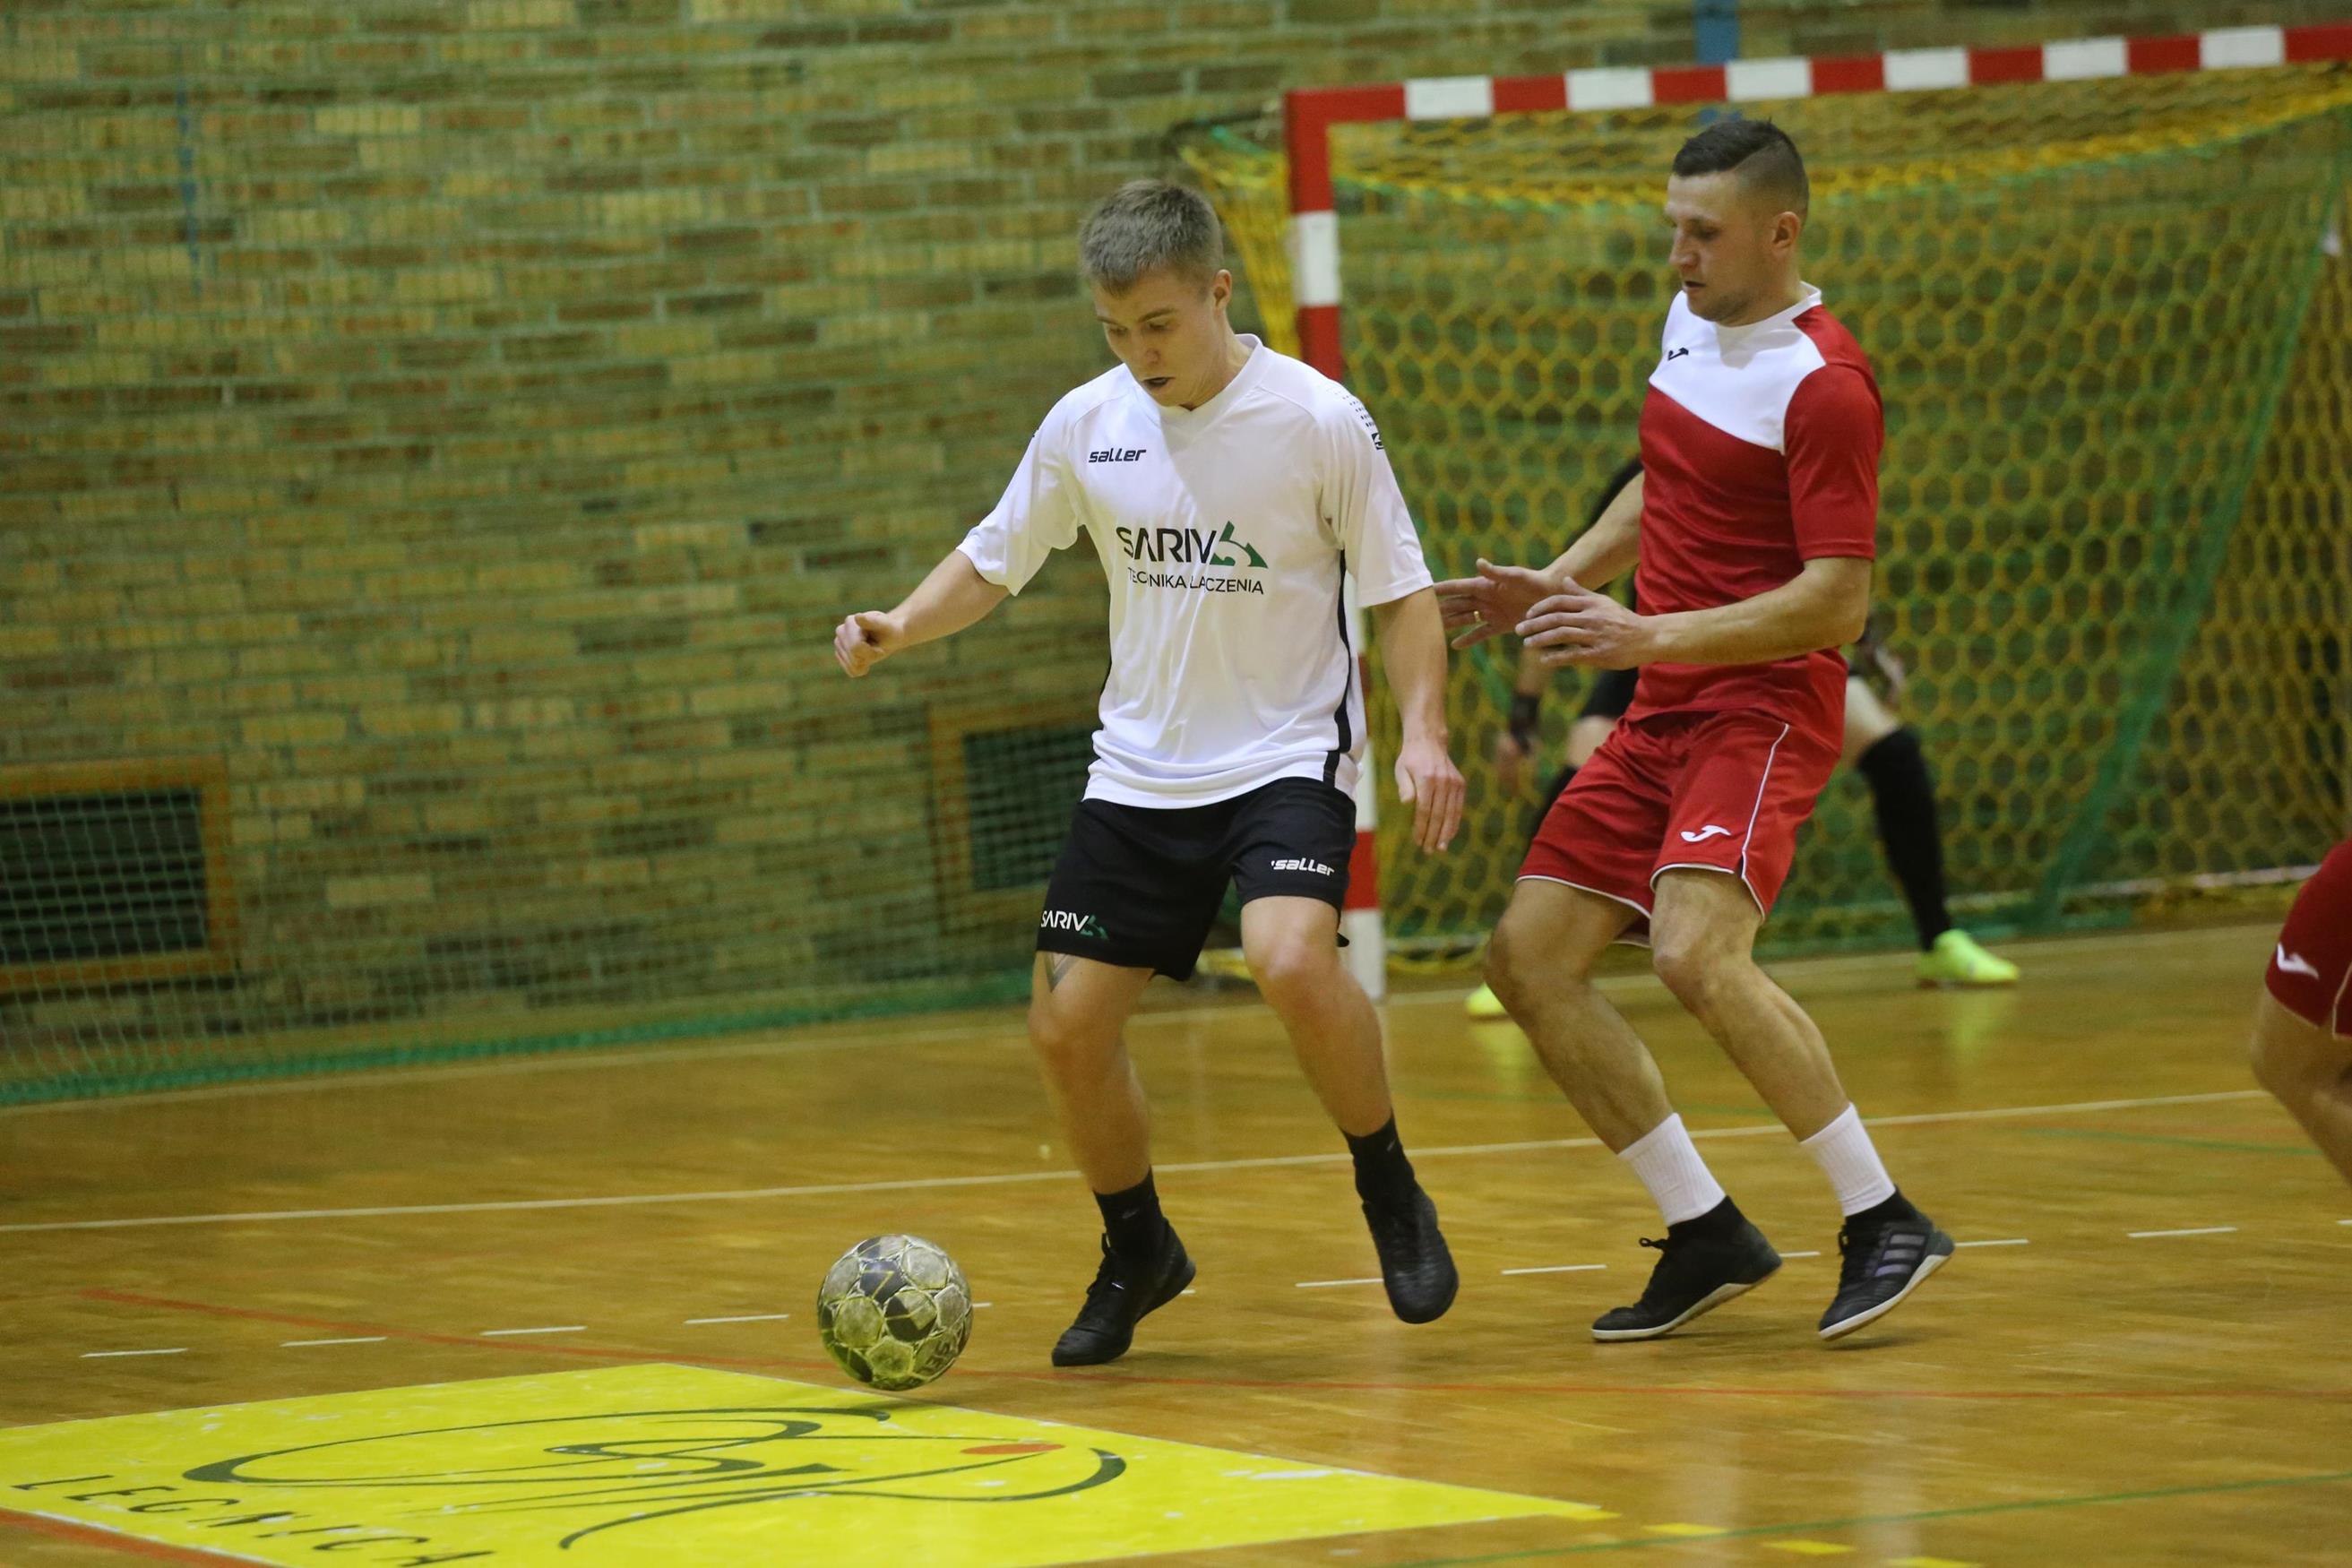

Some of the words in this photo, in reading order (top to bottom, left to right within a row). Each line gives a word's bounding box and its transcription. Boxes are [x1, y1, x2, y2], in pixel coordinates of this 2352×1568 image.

[1089, 448, 1147, 463] saller
[1127, 567, 1187, 589] TECNIKA
[1272, 857, 1335, 876] saller
